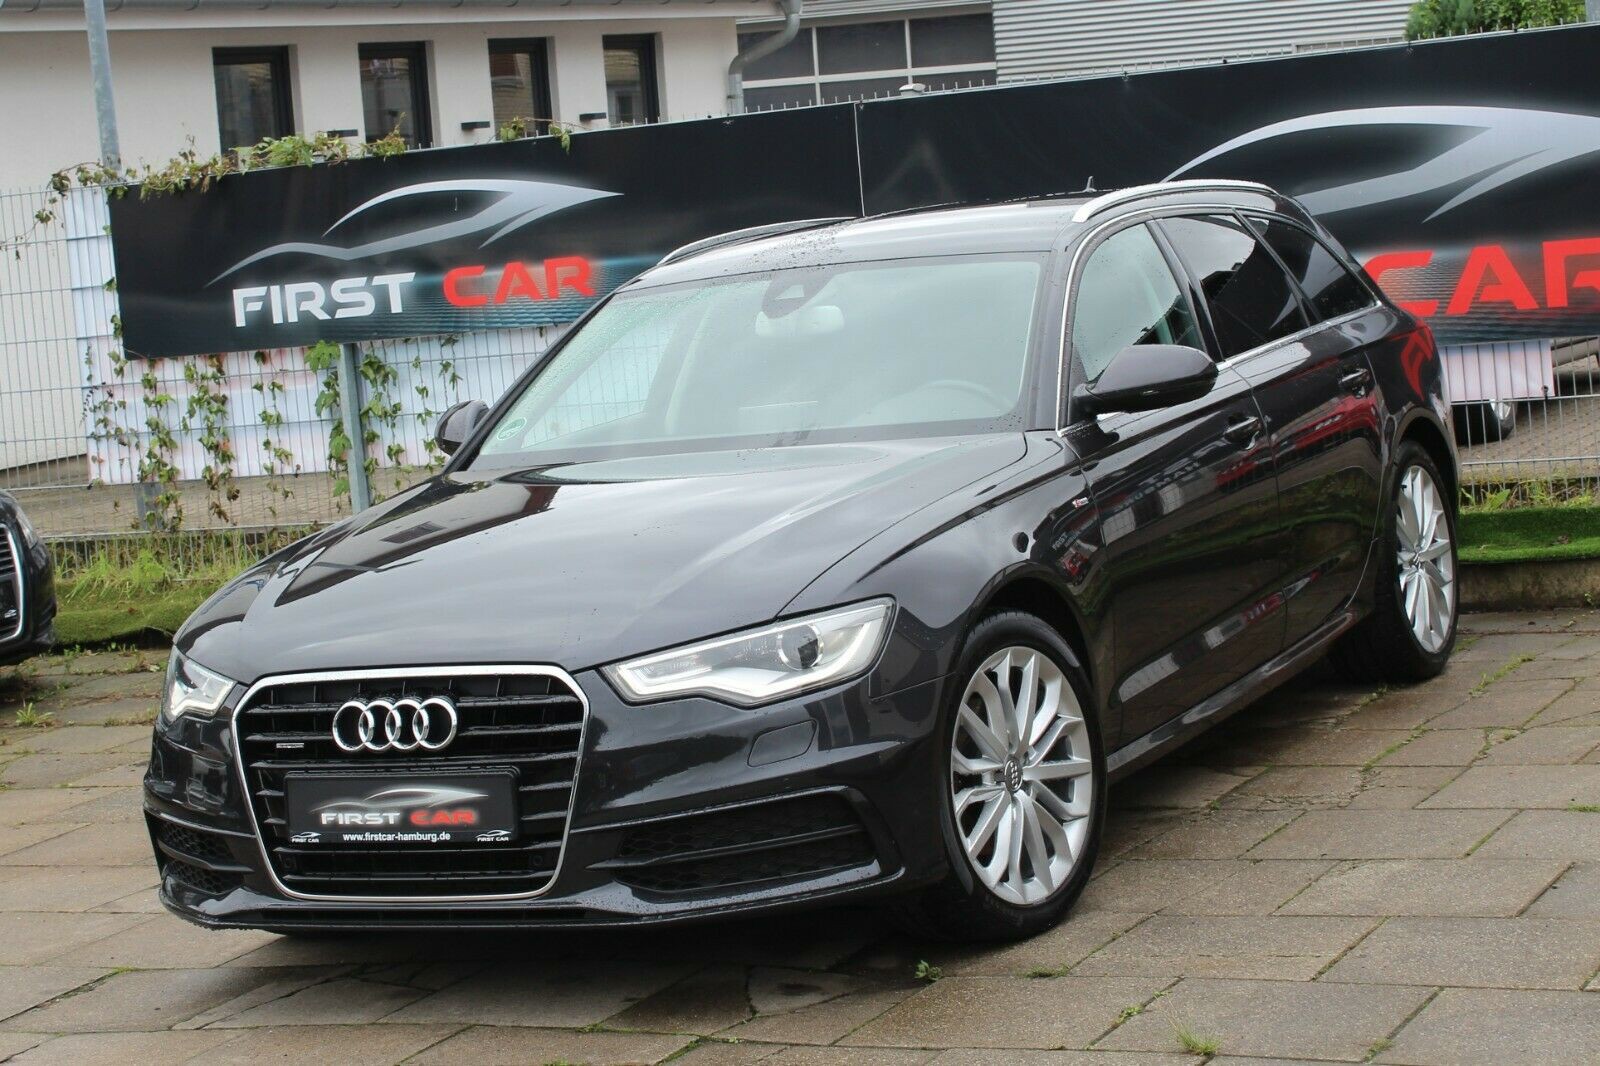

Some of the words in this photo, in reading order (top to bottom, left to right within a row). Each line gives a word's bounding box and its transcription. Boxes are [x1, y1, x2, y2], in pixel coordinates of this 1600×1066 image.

[232, 271, 416, 328] FIRST
[443, 255, 596, 307] CAR
[320, 811, 401, 825] FIRST
[410, 810, 476, 825] CAR
[343, 831, 451, 843] www.firstcar-hamburg.de
